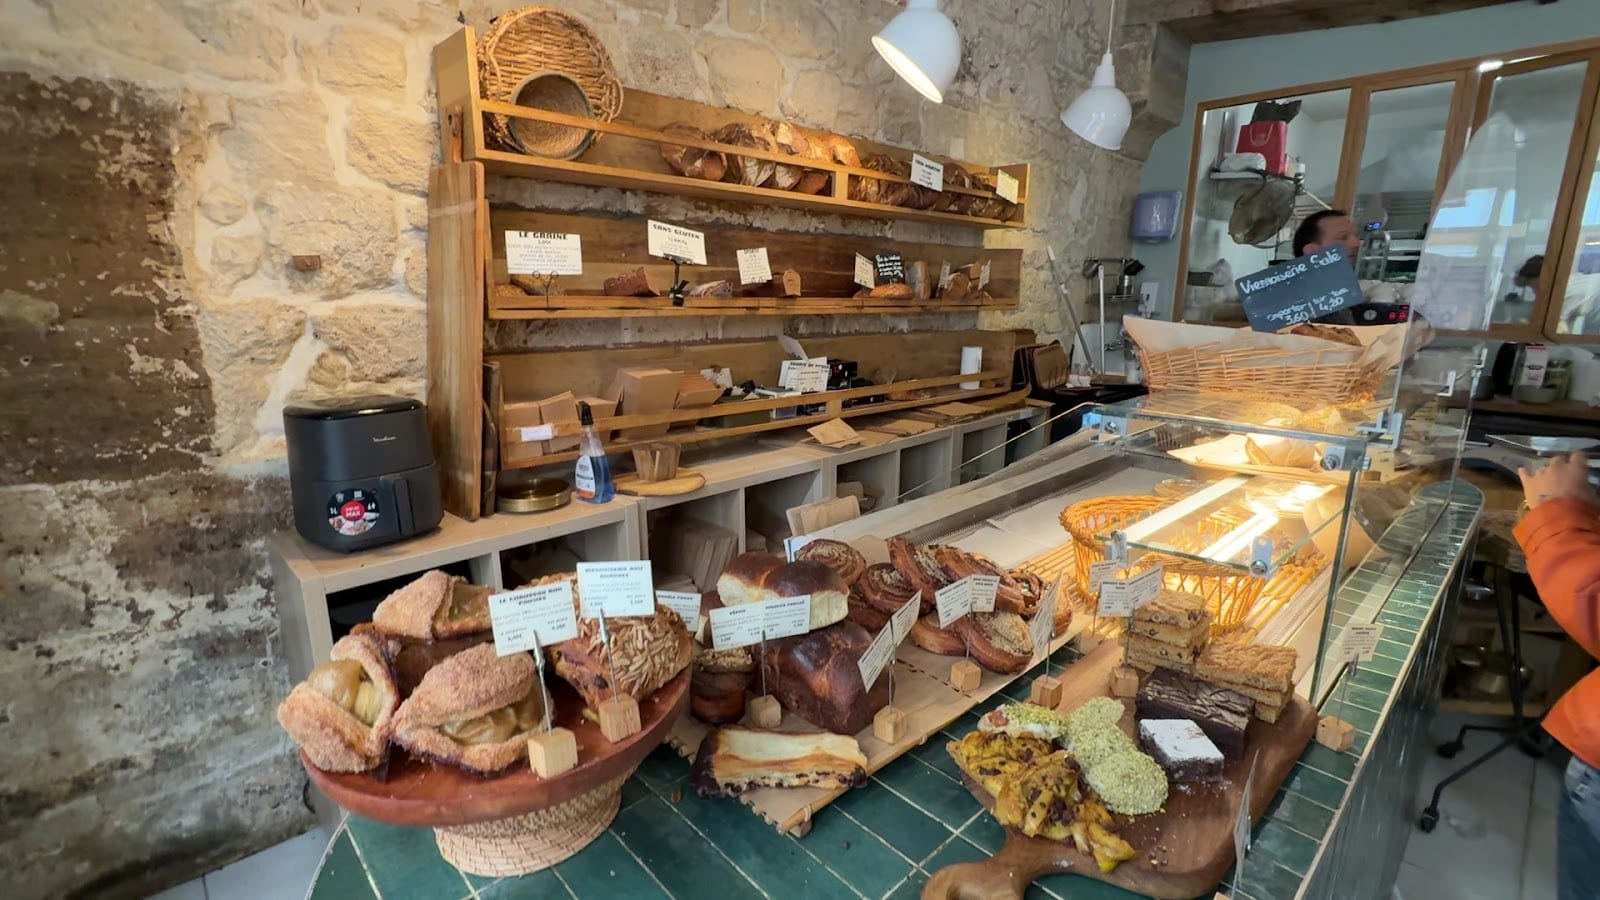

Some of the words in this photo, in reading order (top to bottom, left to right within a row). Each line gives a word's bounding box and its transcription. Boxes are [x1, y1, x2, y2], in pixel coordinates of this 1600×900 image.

[653, 224, 671, 233] SANS
[674, 229, 700, 240] GLUTEN
[1310, 249, 1342, 269] Salé
